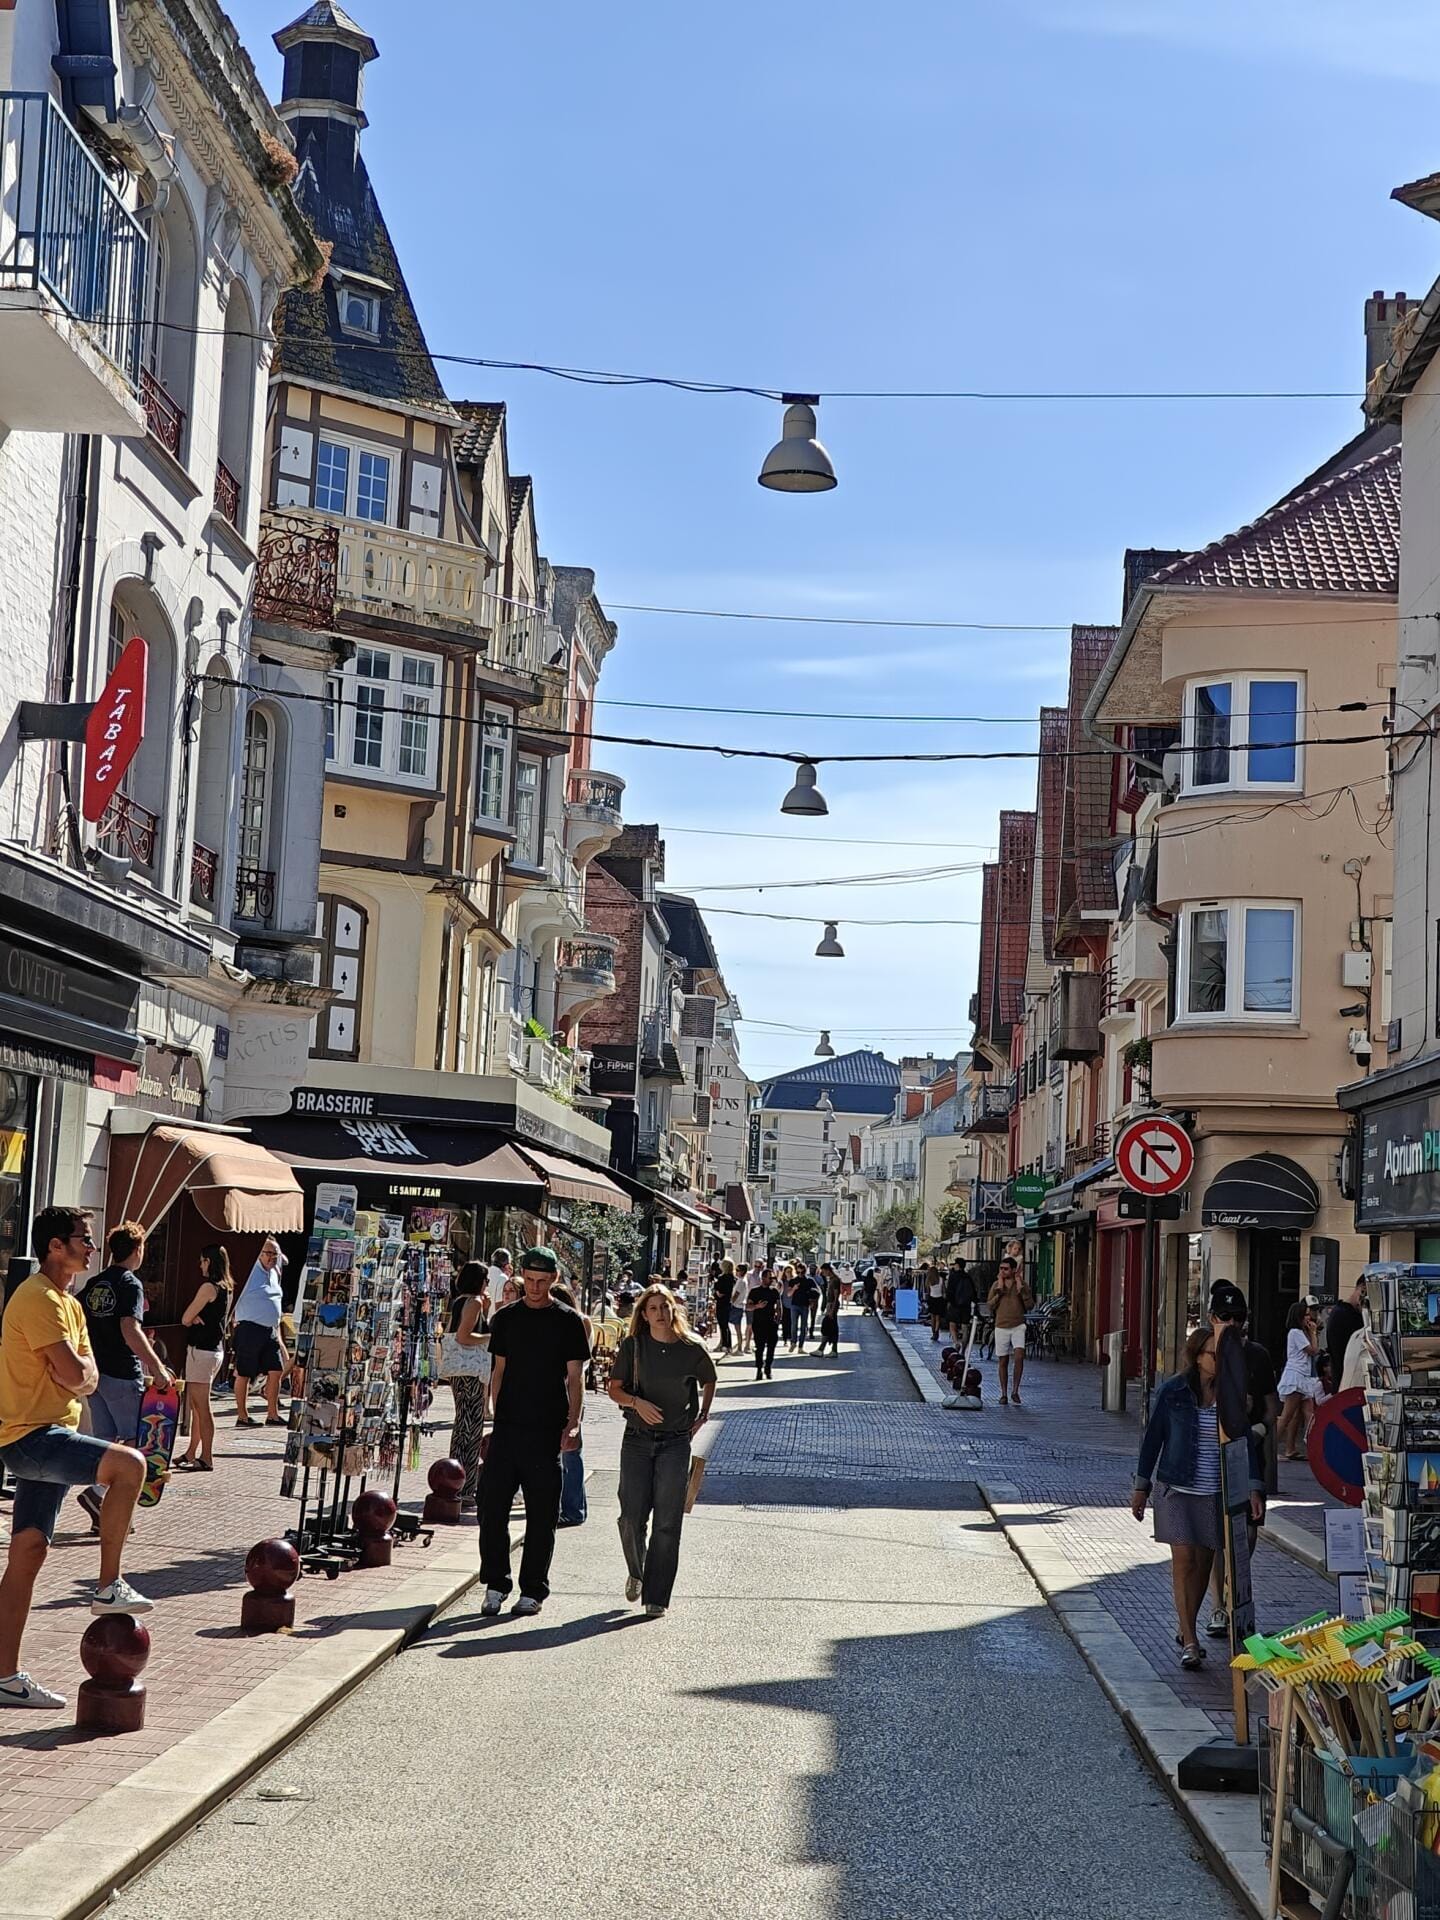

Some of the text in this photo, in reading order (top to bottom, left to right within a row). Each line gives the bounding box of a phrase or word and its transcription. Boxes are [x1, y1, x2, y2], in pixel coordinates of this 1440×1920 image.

[95, 688, 132, 782] TABAC
[7, 949, 67, 1005] CIVETTE
[592, 1061, 604, 1070] LA
[296, 1092, 375, 1116] BRASSERIE
[339, 1118, 409, 1140] SAINT
[750, 1115, 760, 1157] HOTEL
[356, 1136, 429, 1159] JEAN
[1383, 1133, 1424, 1186] Aprium
[389, 1185, 441, 1198] LE SAINT JEAN
[434, 1223, 441, 1235] 3
